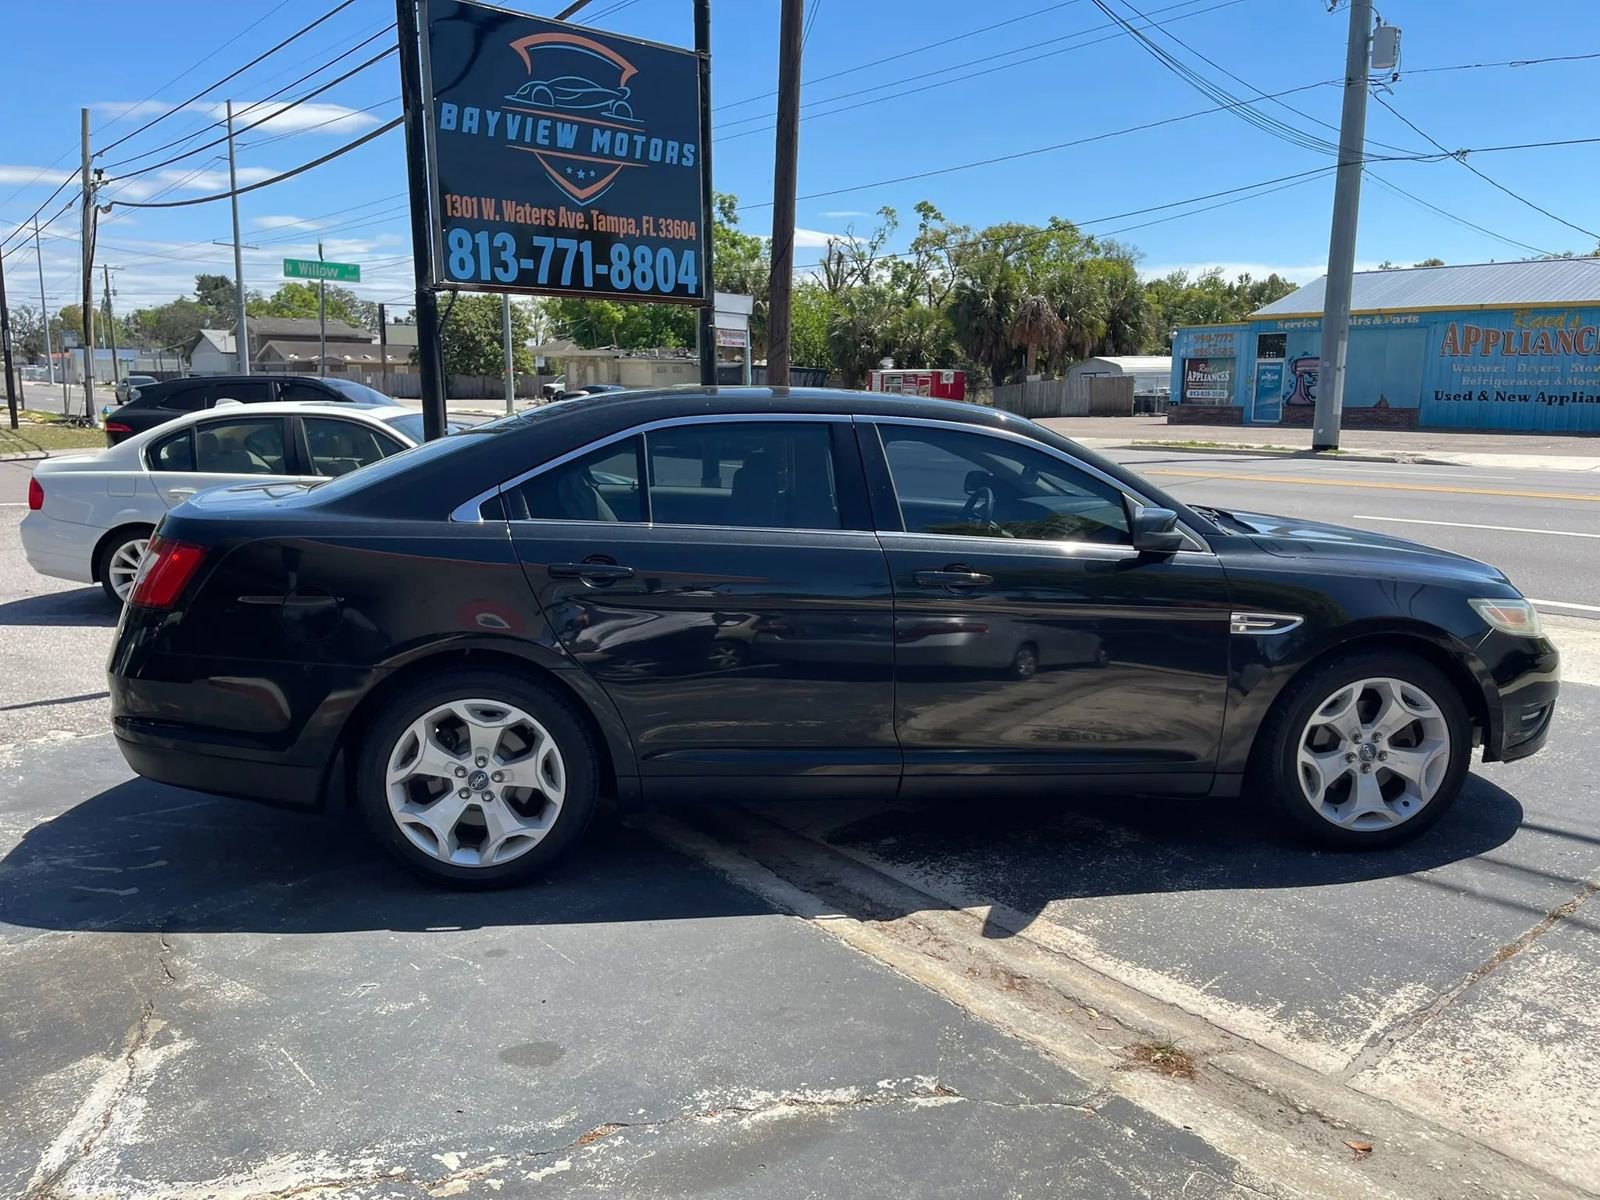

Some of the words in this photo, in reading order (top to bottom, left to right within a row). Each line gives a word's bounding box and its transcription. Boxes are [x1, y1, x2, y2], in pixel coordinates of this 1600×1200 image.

[440, 103, 578, 149] BAYVIEW
[591, 128, 696, 168] MOTORS
[445, 193, 478, 219] 1301
[481, 197, 500, 221] W.
[502, 199, 556, 227] Waters
[558, 206, 589, 230] Ave.
[591, 209, 640, 238] Tampa,
[642, 215, 657, 236] FL
[658, 218, 697, 240] 33604
[448, 227, 698, 294] 813-771-8804
[299, 262, 339, 278] Willow
[1277, 319, 1319, 329] Service
[1383, 314, 1420, 325] Parts
[1452, 363, 1506, 373] Washers
[1187, 370, 1230, 382] APPLIANCES
[1461, 376, 1550, 388] Refrigerators
[1434, 390, 1473, 402] Used
[1477, 390, 1490, 402] &
[1495, 391, 1532, 403] New
